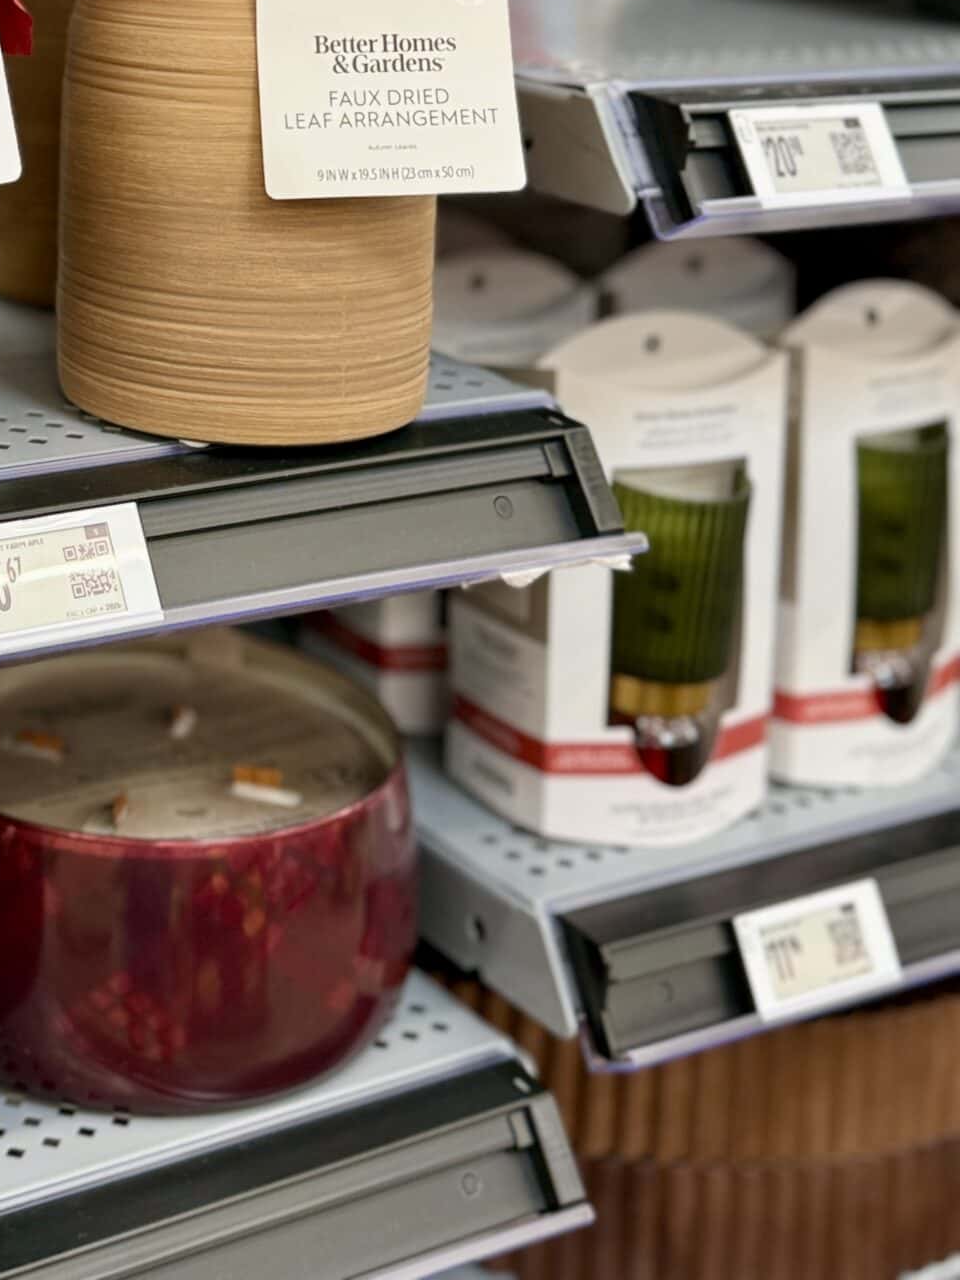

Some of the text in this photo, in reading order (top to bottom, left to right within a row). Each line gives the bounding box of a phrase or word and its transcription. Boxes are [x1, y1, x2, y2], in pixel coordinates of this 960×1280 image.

[314, 34, 457, 54] Better Homes
[352, 54, 443, 74] Gardens
[329, 88, 449, 108] FAUX DRIED
[284, 108, 498, 130] LEAF ARRANGEMENT
[317, 169, 324, 182] 9
[338, 169, 349, 181] W
[359, 167, 378, 180] 19.5
[391, 167, 399, 180] H
[417, 169, 432, 179] cm
[442, 166, 454, 178] 50
